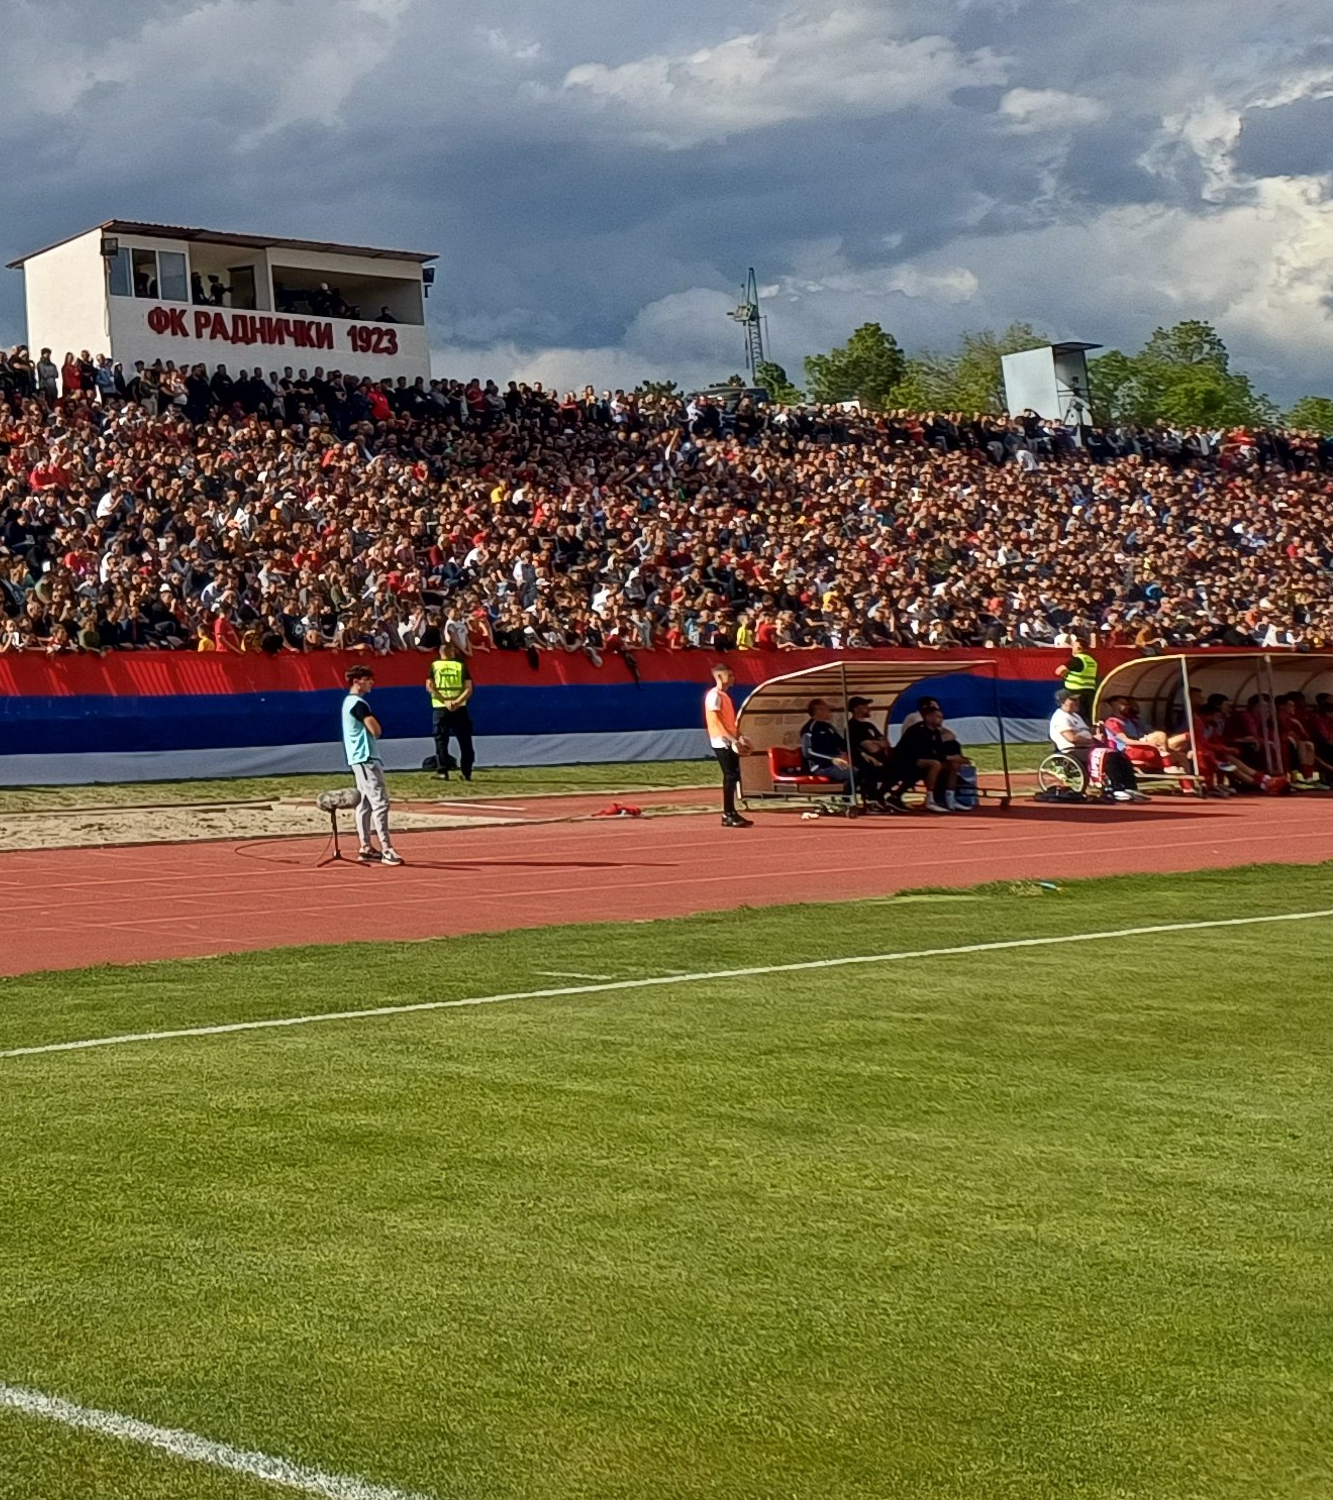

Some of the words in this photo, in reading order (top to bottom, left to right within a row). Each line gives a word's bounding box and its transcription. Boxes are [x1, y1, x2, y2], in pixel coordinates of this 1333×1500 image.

[147, 306, 189, 337] ФК
[194, 311, 334, 349] РАДНИЧКИ
[346, 325, 398, 355] 1923
